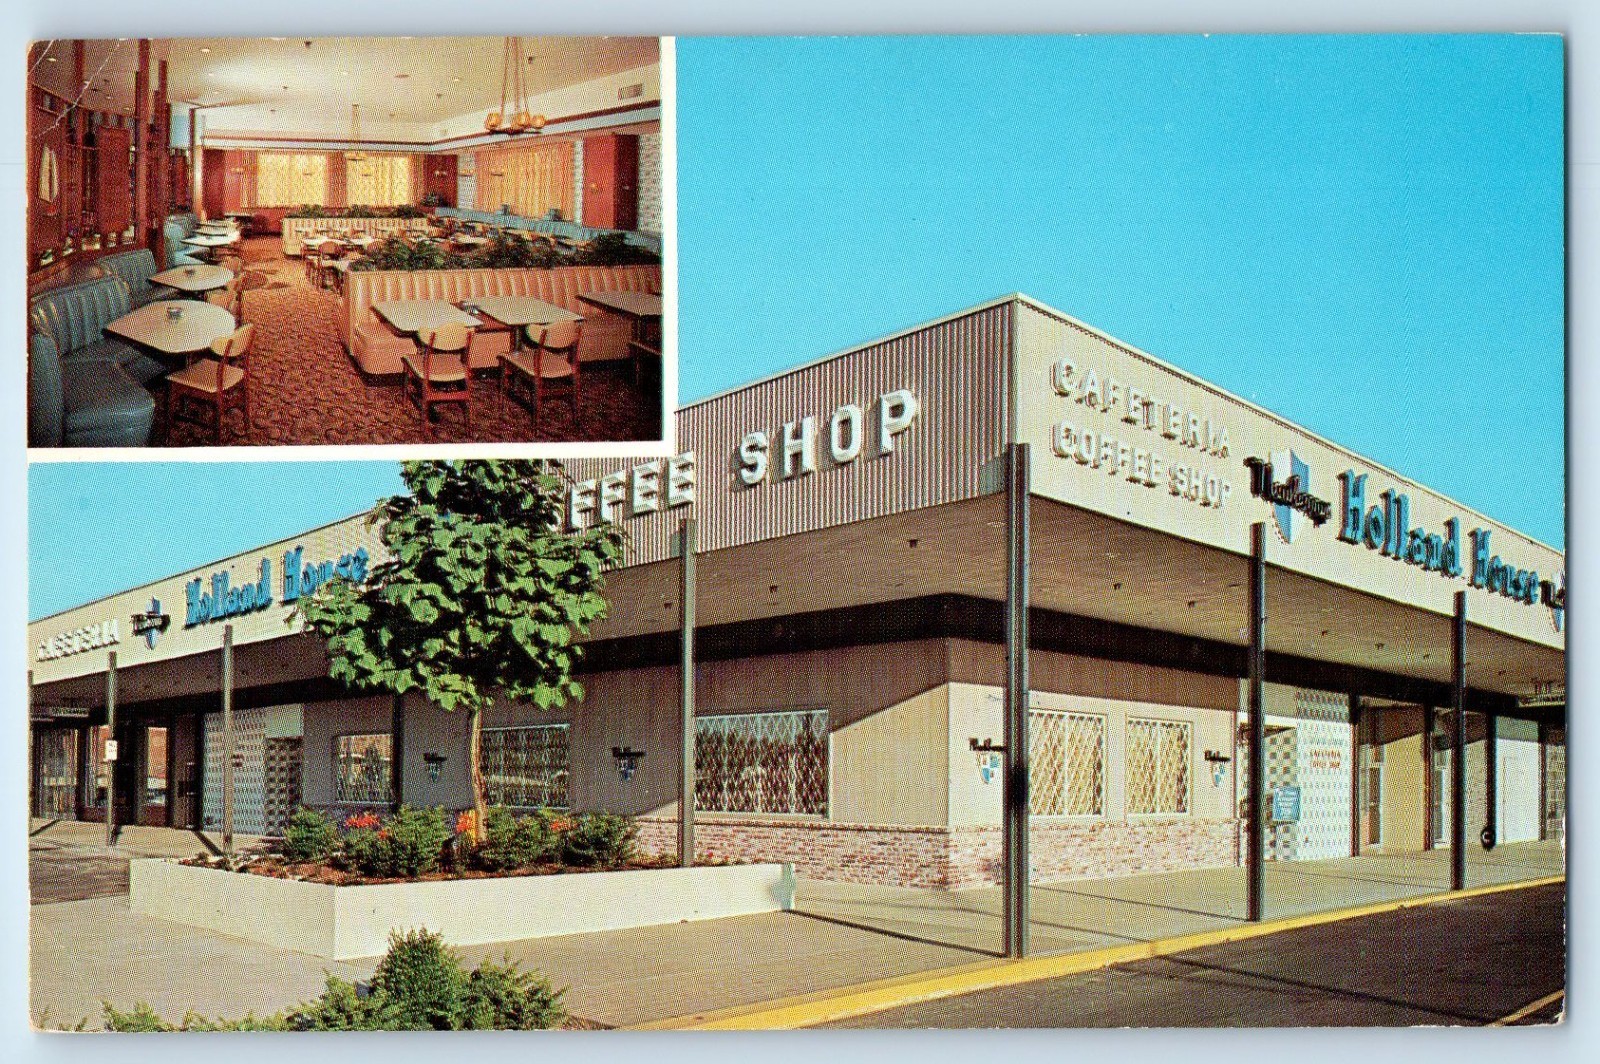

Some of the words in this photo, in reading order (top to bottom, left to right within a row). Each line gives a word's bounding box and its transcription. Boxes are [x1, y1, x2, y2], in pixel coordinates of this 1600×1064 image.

[1051, 358, 1231, 459] CAFETERIA
[568, 450, 695, 533] FFEE
[738, 388, 917, 486] SHOP
[1051, 420, 1162, 488] COFFEE
[1167, 464, 1232, 509] SHOP
[184, 557, 273, 629] Holland
[280, 544, 370, 606] House
[1336, 469, 1463, 579] Holland
[1467, 527, 1540, 606] House
